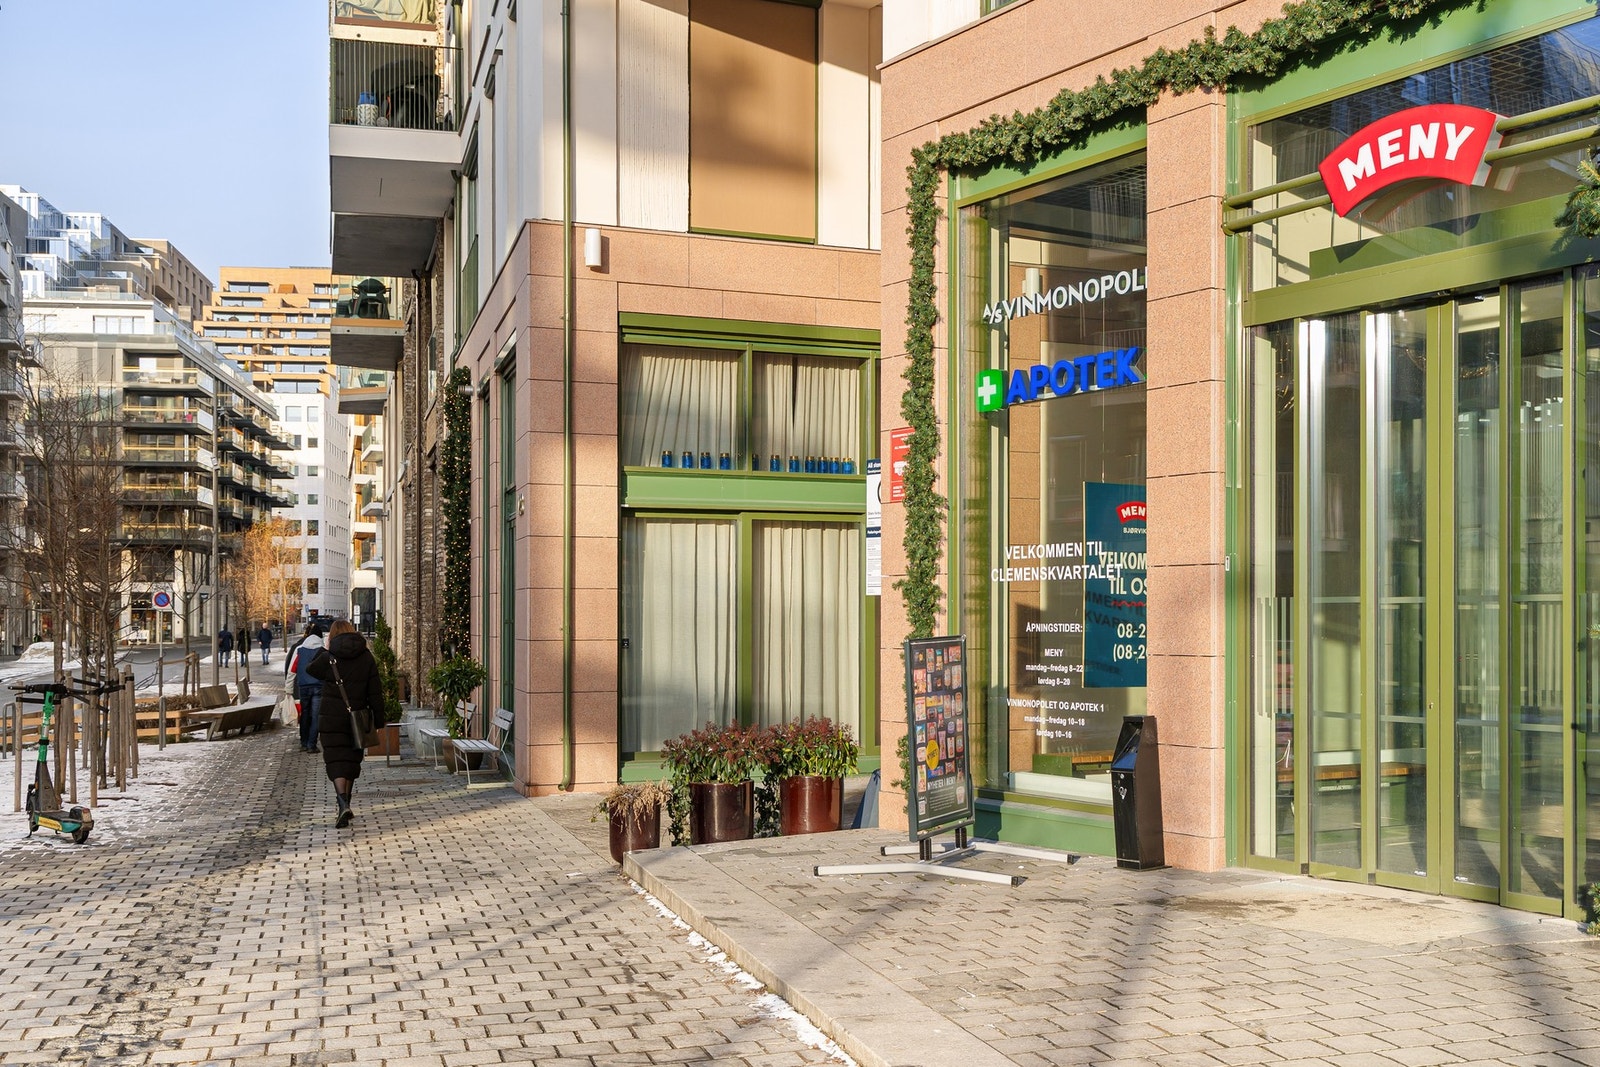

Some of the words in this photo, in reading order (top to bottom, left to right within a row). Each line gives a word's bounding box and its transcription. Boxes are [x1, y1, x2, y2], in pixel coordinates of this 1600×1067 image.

[1337, 122, 1475, 192] MENY
[1002, 266, 1147, 320] VINMONOPOL
[1006, 346, 1140, 404] APOTEK
[1121, 505, 1147, 519] MEN
[1005, 541, 1083, 560] VELKOMMEN
[1086, 541, 1105, 557] TIL
[991, 564, 1123, 583] CLEMENSKVARTALET
[1108, 577, 1127, 595] TIL
[1025, 622, 1083, 633] ÅPNINGSTIDER:
[1044, 648, 1064, 657] MENY
[1113, 643, 1148, 662] (08-2
[1006, 698, 1058, 710] VINMONOPOLET
[1059, 701, 1069, 710] OG
[1070, 702, 1099, 712] APOTEK
[1100, 704, 1105, 712] 1
